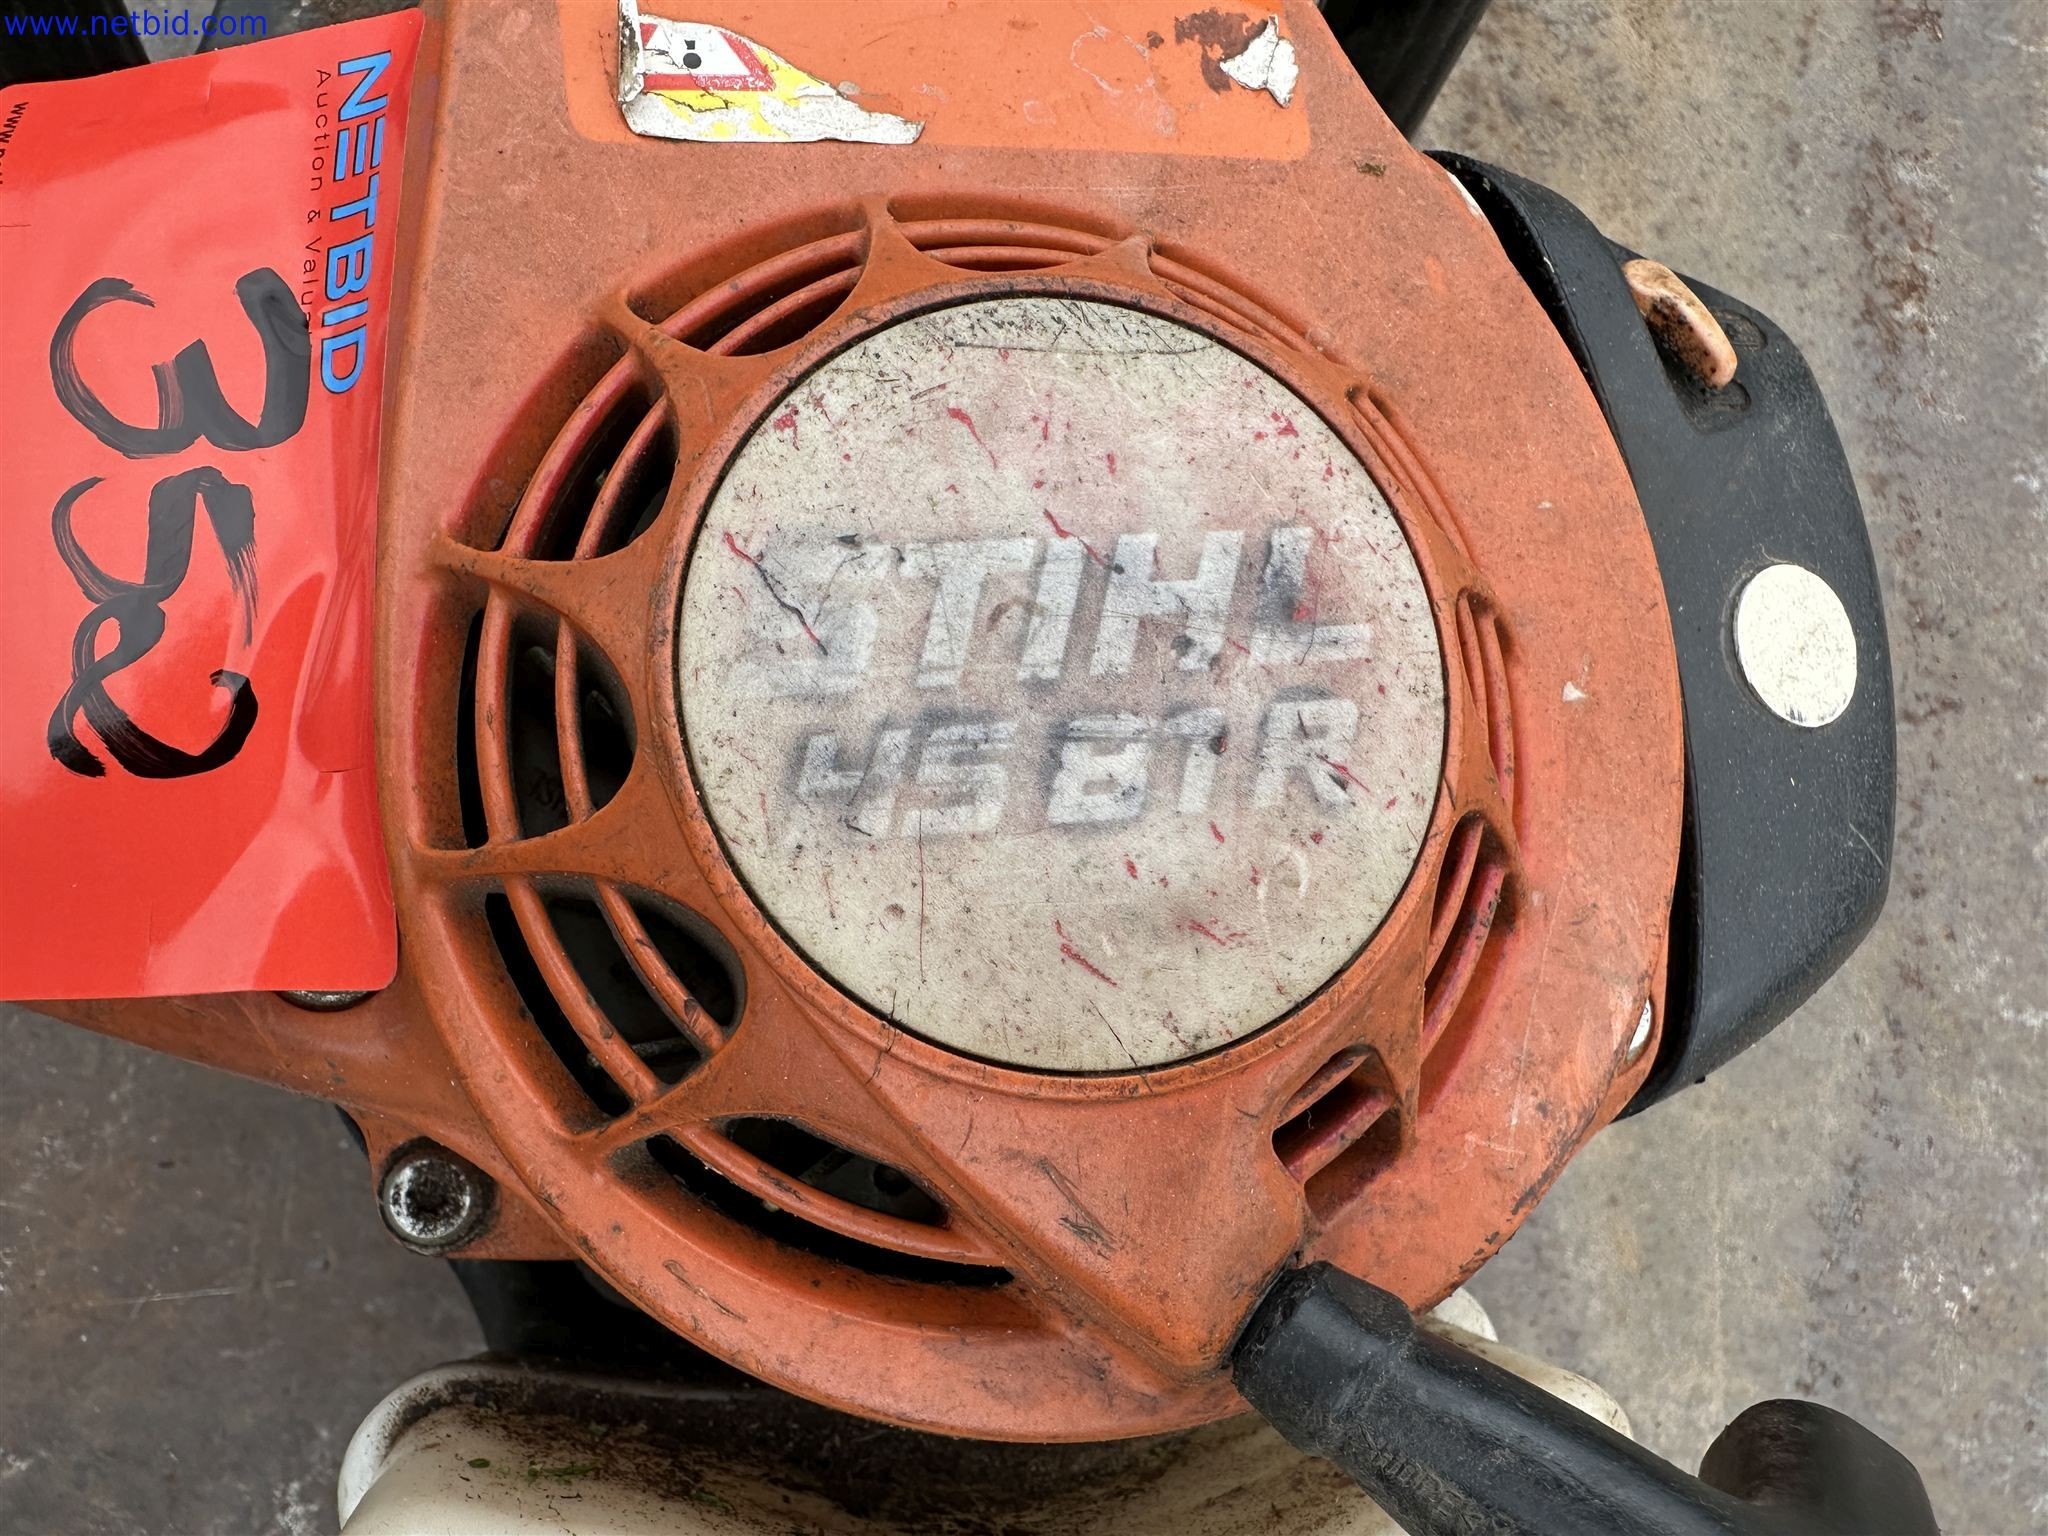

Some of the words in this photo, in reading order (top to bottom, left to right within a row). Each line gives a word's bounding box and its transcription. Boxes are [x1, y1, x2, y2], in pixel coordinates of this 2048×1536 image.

[311, 69, 332, 191] Auction
[307, 209, 321, 224] &
[321, 50, 391, 394] NETBID
[722, 526, 1373, 697] STIHL
